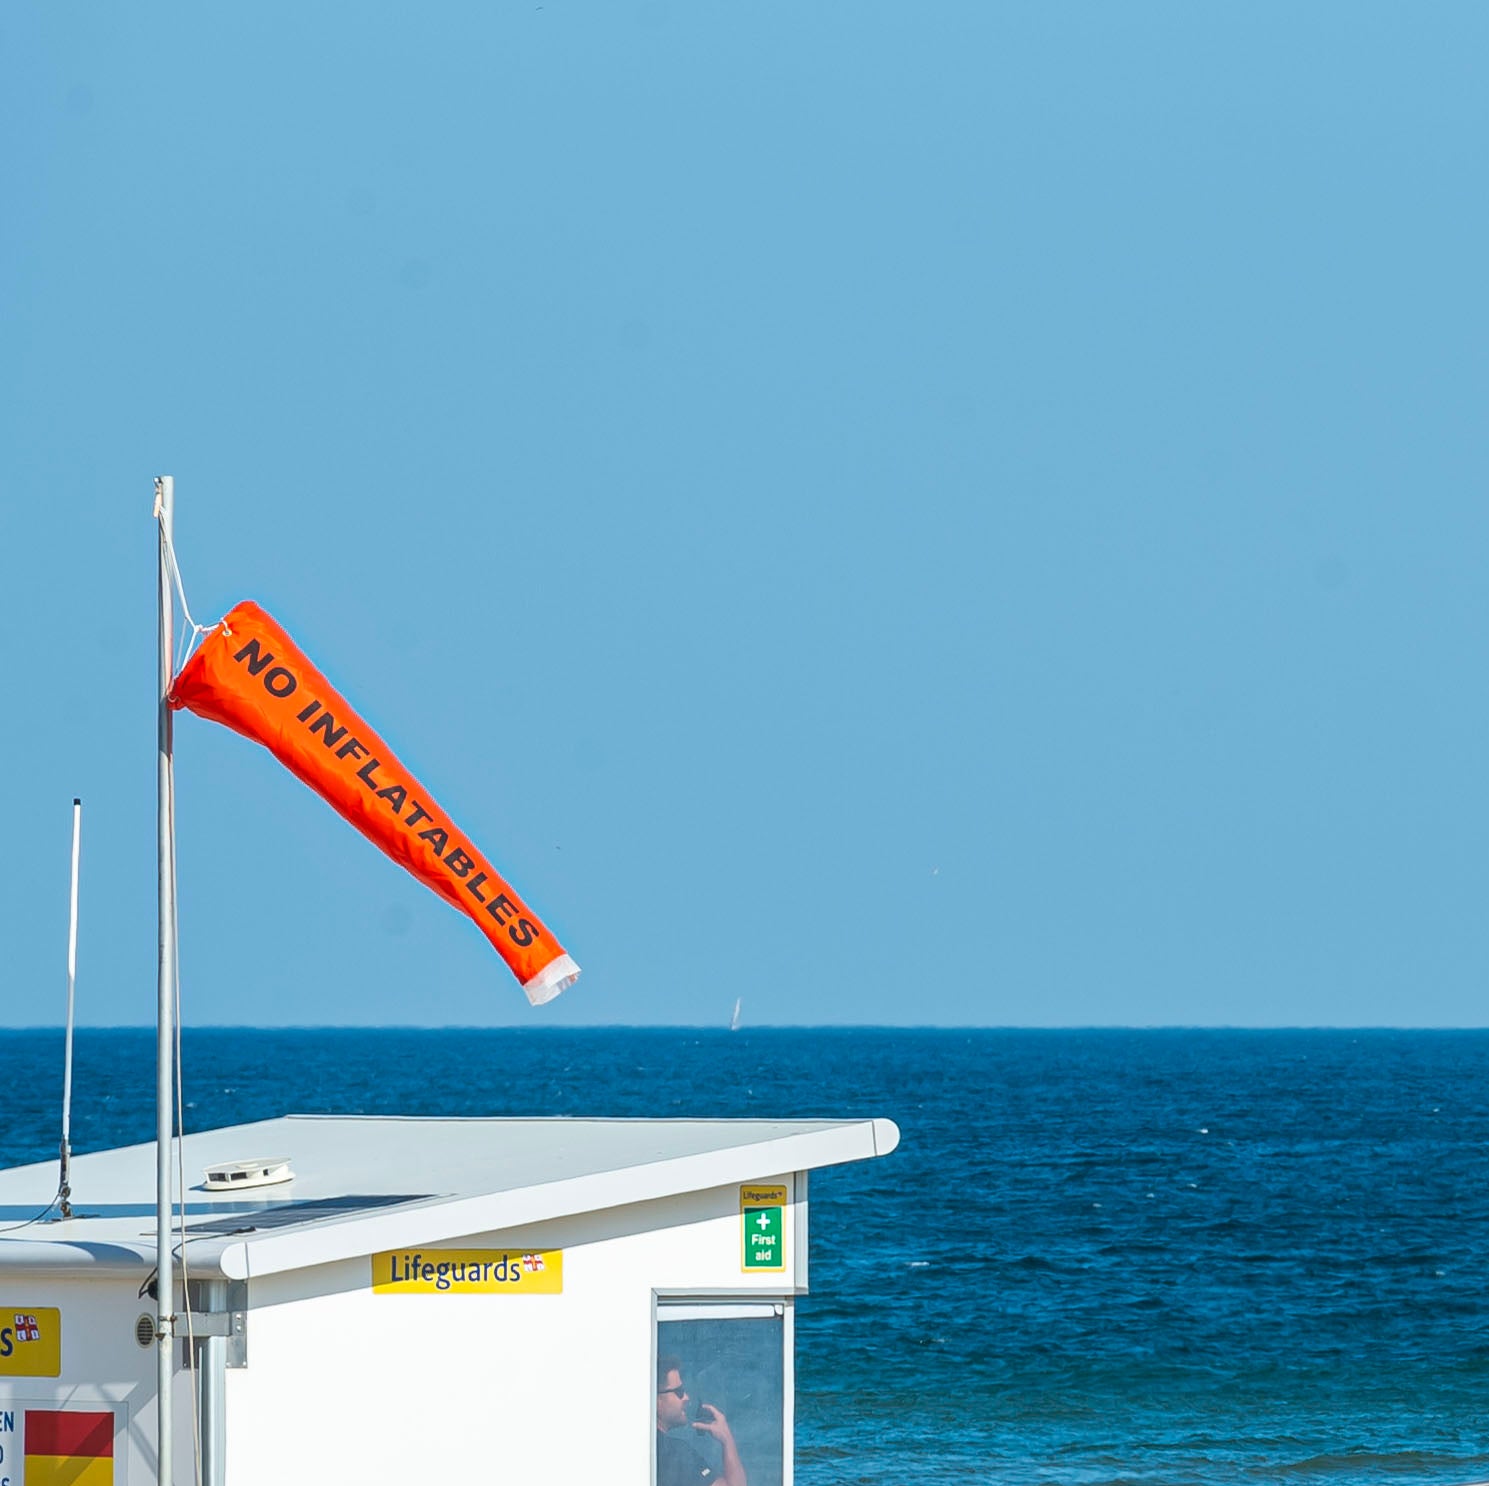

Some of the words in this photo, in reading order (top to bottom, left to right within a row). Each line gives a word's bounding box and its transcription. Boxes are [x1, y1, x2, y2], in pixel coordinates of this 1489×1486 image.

[233, 639, 297, 699] NO
[296, 700, 540, 948] INFLATABLES
[751, 1233, 776, 1245] First
[755, 1249, 772, 1261] aid
[391, 1254, 521, 1290] Lifeguards
